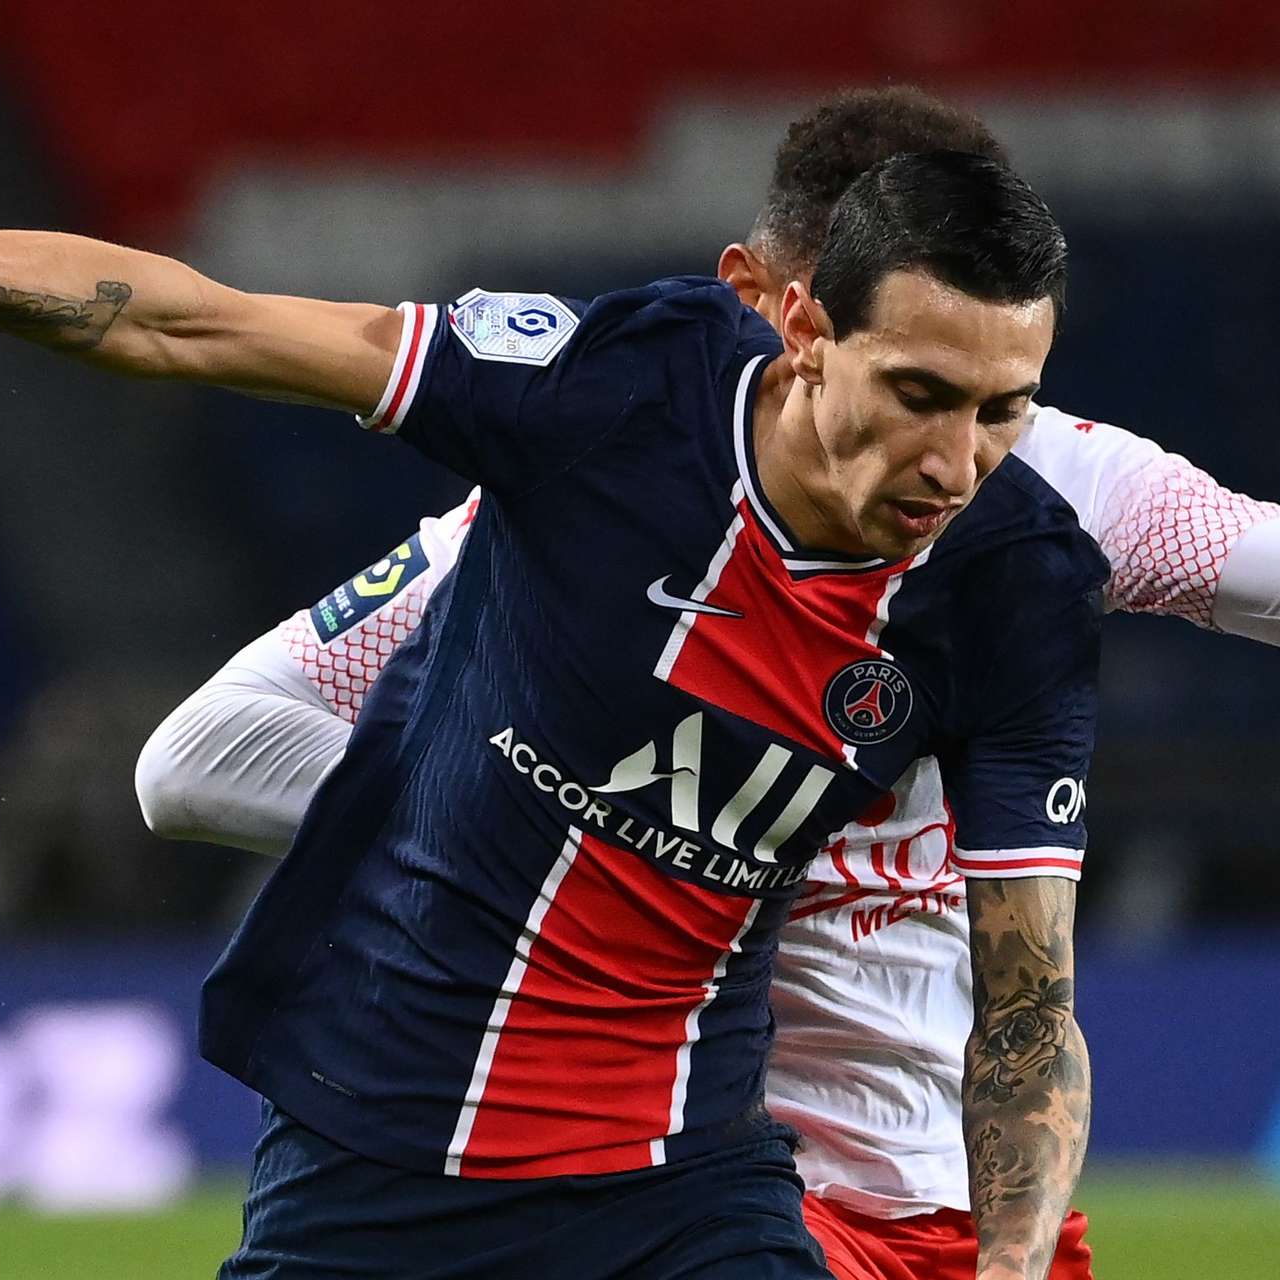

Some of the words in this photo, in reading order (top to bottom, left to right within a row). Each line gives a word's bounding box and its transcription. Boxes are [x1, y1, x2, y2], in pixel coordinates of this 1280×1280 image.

[852, 665, 906, 693] PARIS
[489, 726, 613, 828] ACCOR
[616, 818, 702, 869] LIVE
[1045, 777, 1087, 824] QN
